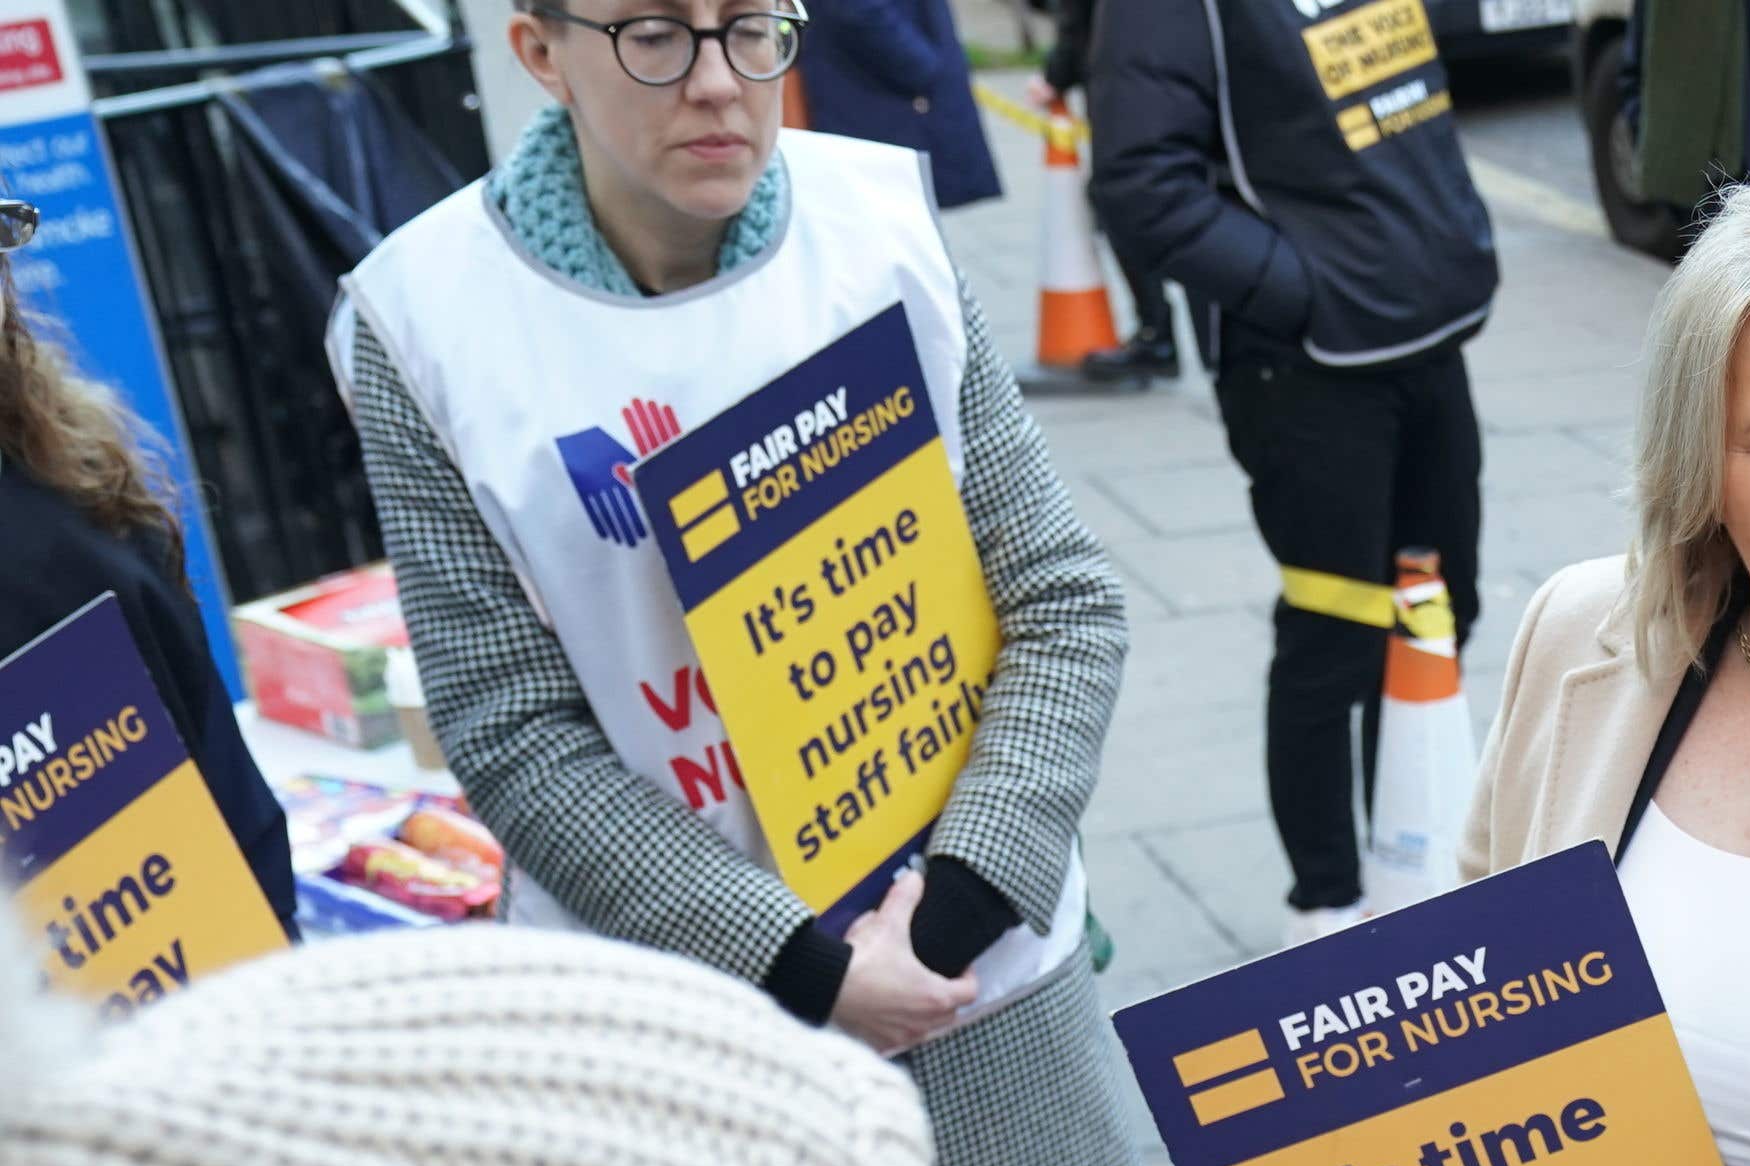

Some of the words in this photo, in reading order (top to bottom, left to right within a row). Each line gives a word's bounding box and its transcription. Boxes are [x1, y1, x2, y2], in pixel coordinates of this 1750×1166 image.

[729, 425, 799, 489] FAIR
[794, 385, 849, 446] PAY
[742, 463, 801, 522] FOR
[799, 386, 915, 482] NURSING
[743, 583, 816, 656] It's
[820, 508, 920, 598] time
[788, 650, 837, 702] to
[845, 580, 918, 675] pay
[797, 633, 958, 779] nursing
[0, 705, 149, 832] NURSING
[794, 747, 892, 863] staff
[46, 852, 177, 970] time
[1278, 986, 1396, 1052] FAIR
[1396, 946, 1487, 1010] PAY
[1296, 1031, 1395, 1089] FOR
[1400, 951, 1614, 1053] NURSING
